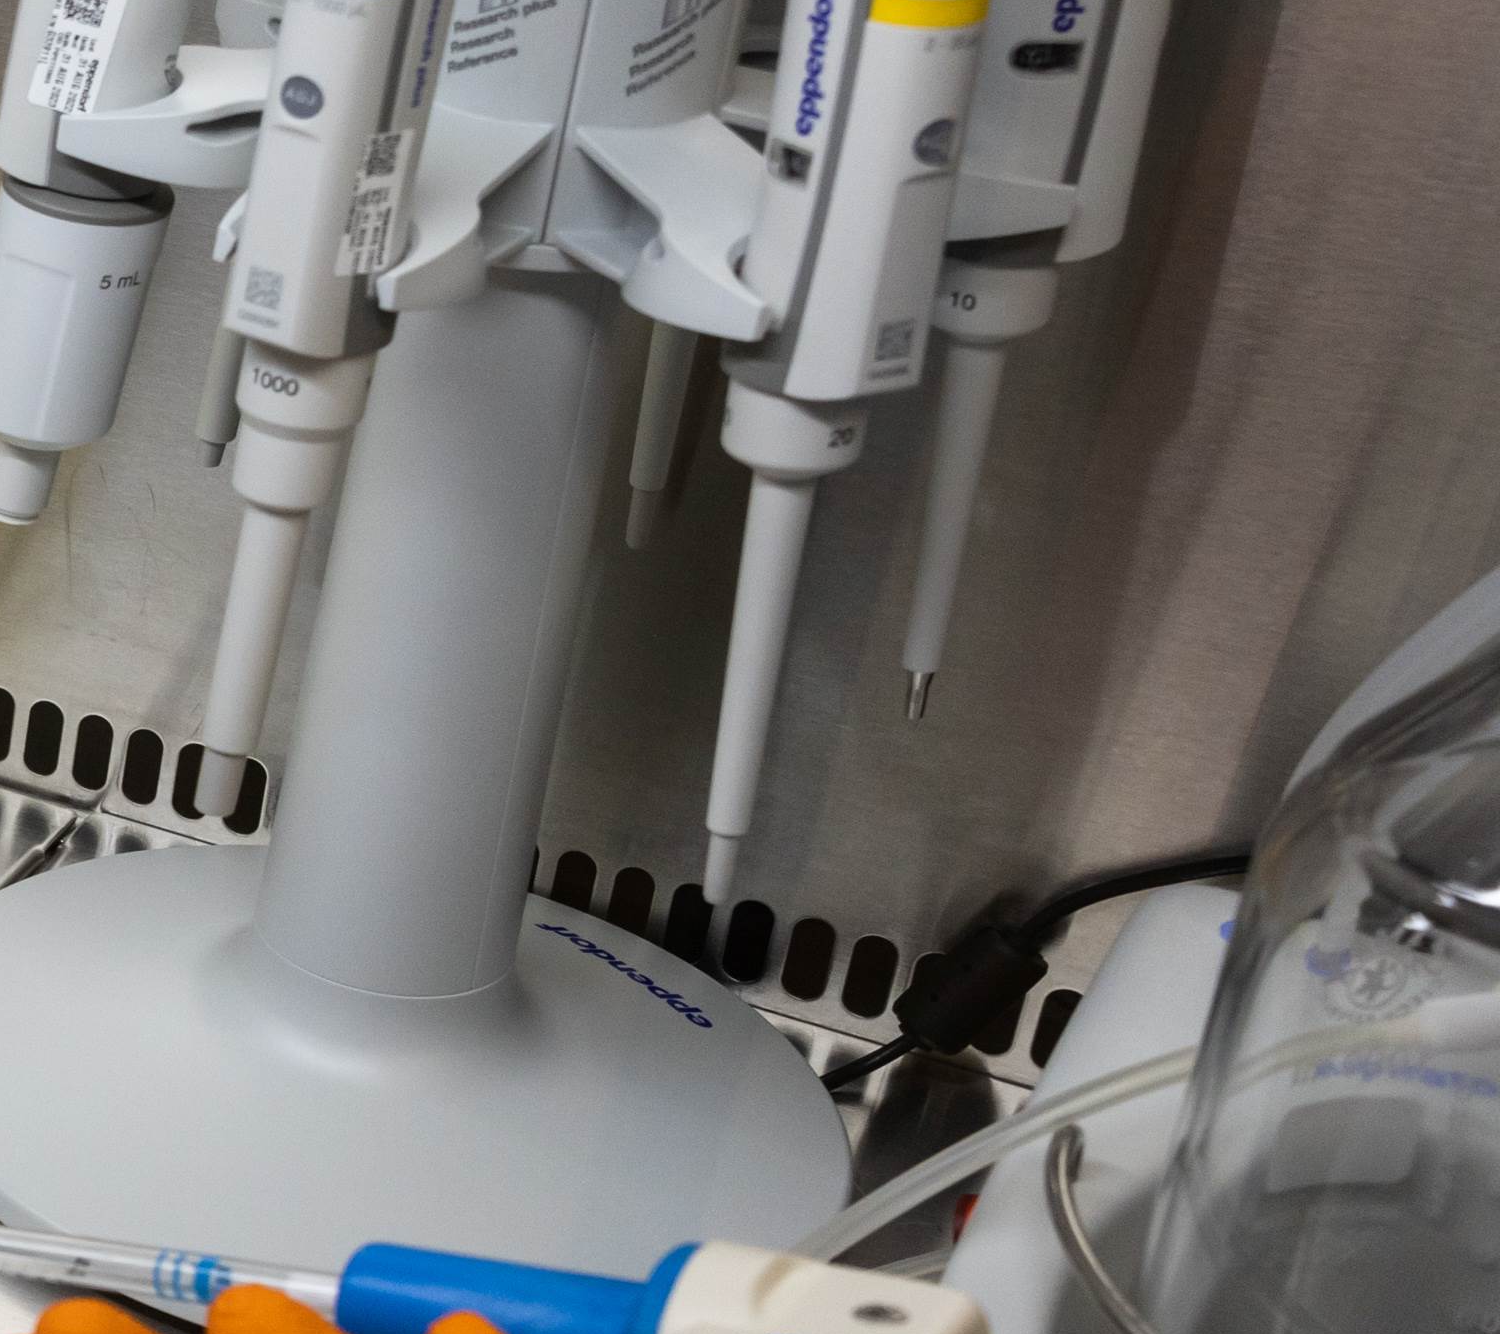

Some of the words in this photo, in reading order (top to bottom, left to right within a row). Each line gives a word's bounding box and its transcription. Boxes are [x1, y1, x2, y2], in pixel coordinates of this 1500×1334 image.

[453, 6, 519, 34] Research
[450, 26, 516, 53] Research
[99, 275, 112, 290] 5
[116, 270, 141, 290] mL
[951, 291, 977, 311] 10
[252, 368, 299, 397] 1000
[534, 922, 713, 1029] eppendorf
